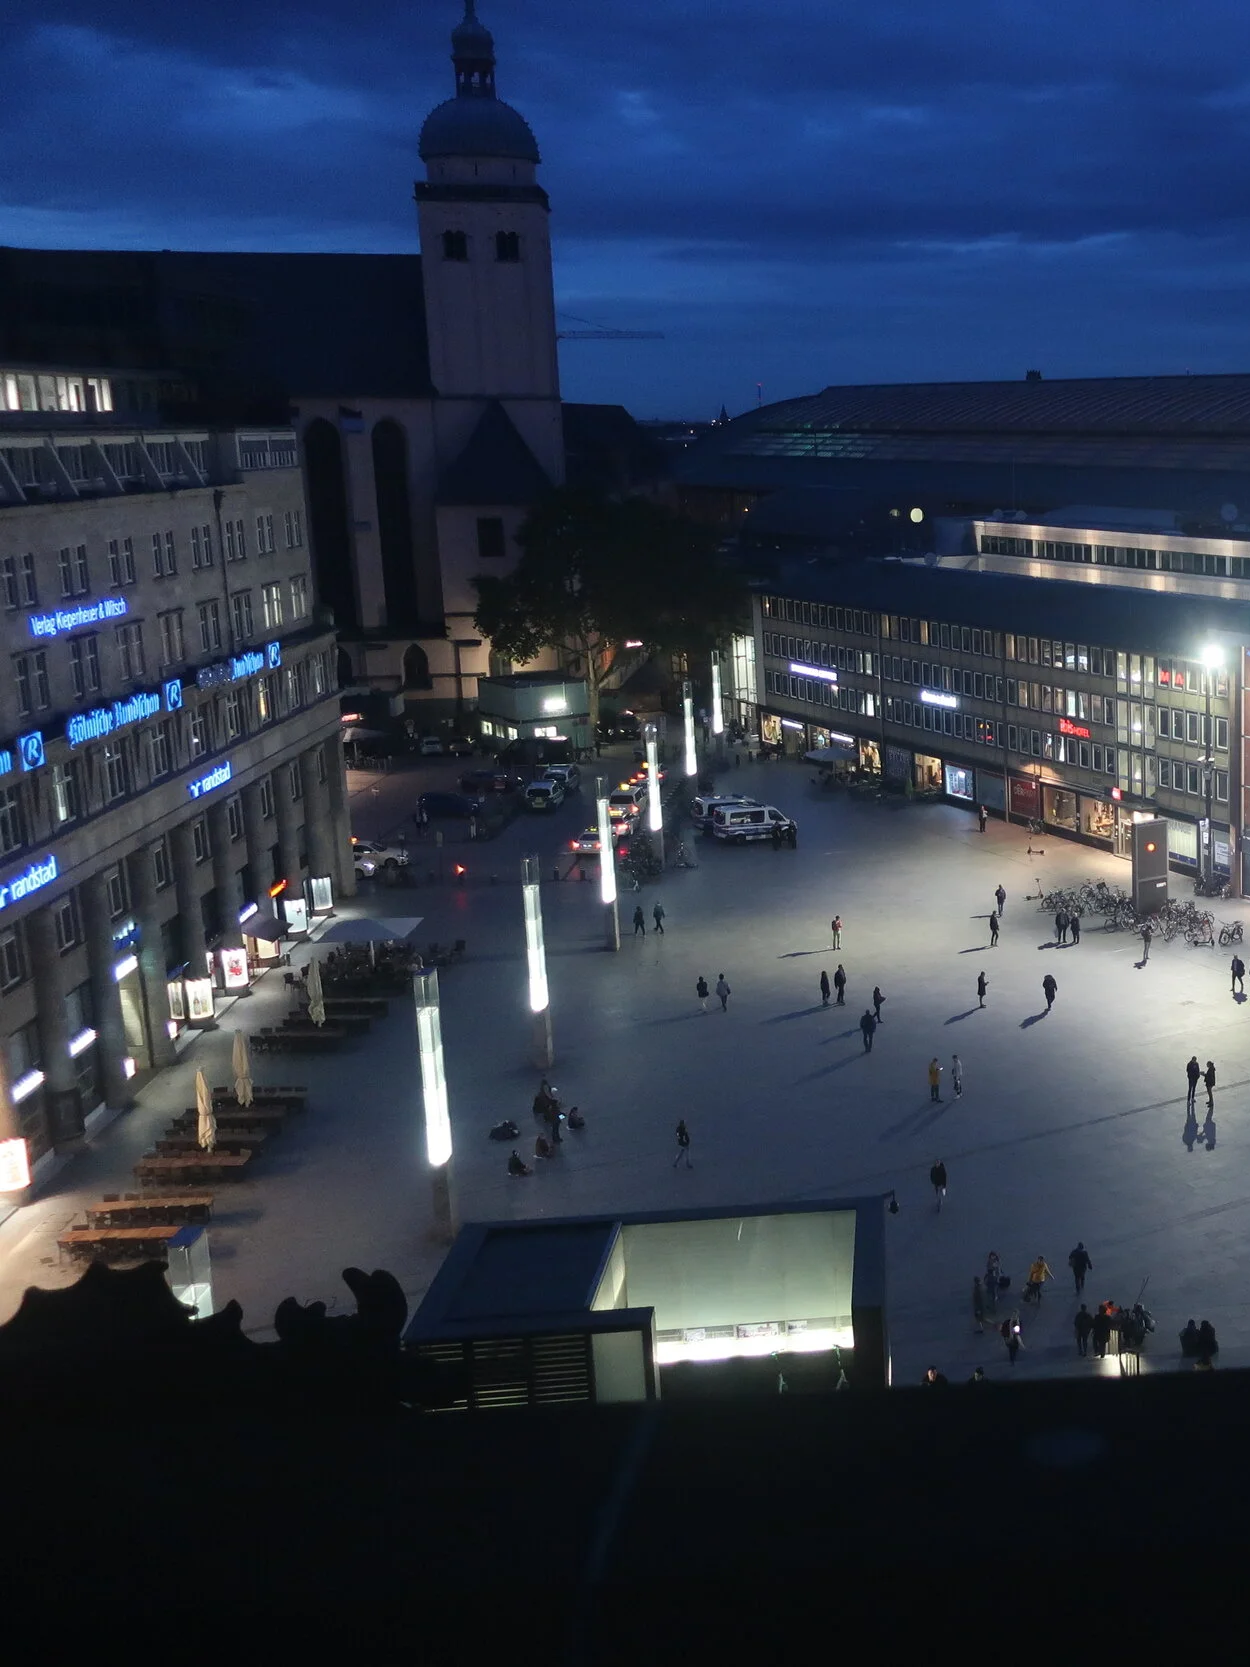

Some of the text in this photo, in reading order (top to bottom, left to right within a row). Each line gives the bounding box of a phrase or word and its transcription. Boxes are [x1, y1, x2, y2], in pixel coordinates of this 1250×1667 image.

[31, 597, 126, 635] Verlag Kiepenheuer & Witsch
[202, 760, 232, 793] randstad
[11, 855, 58, 900] randstad
